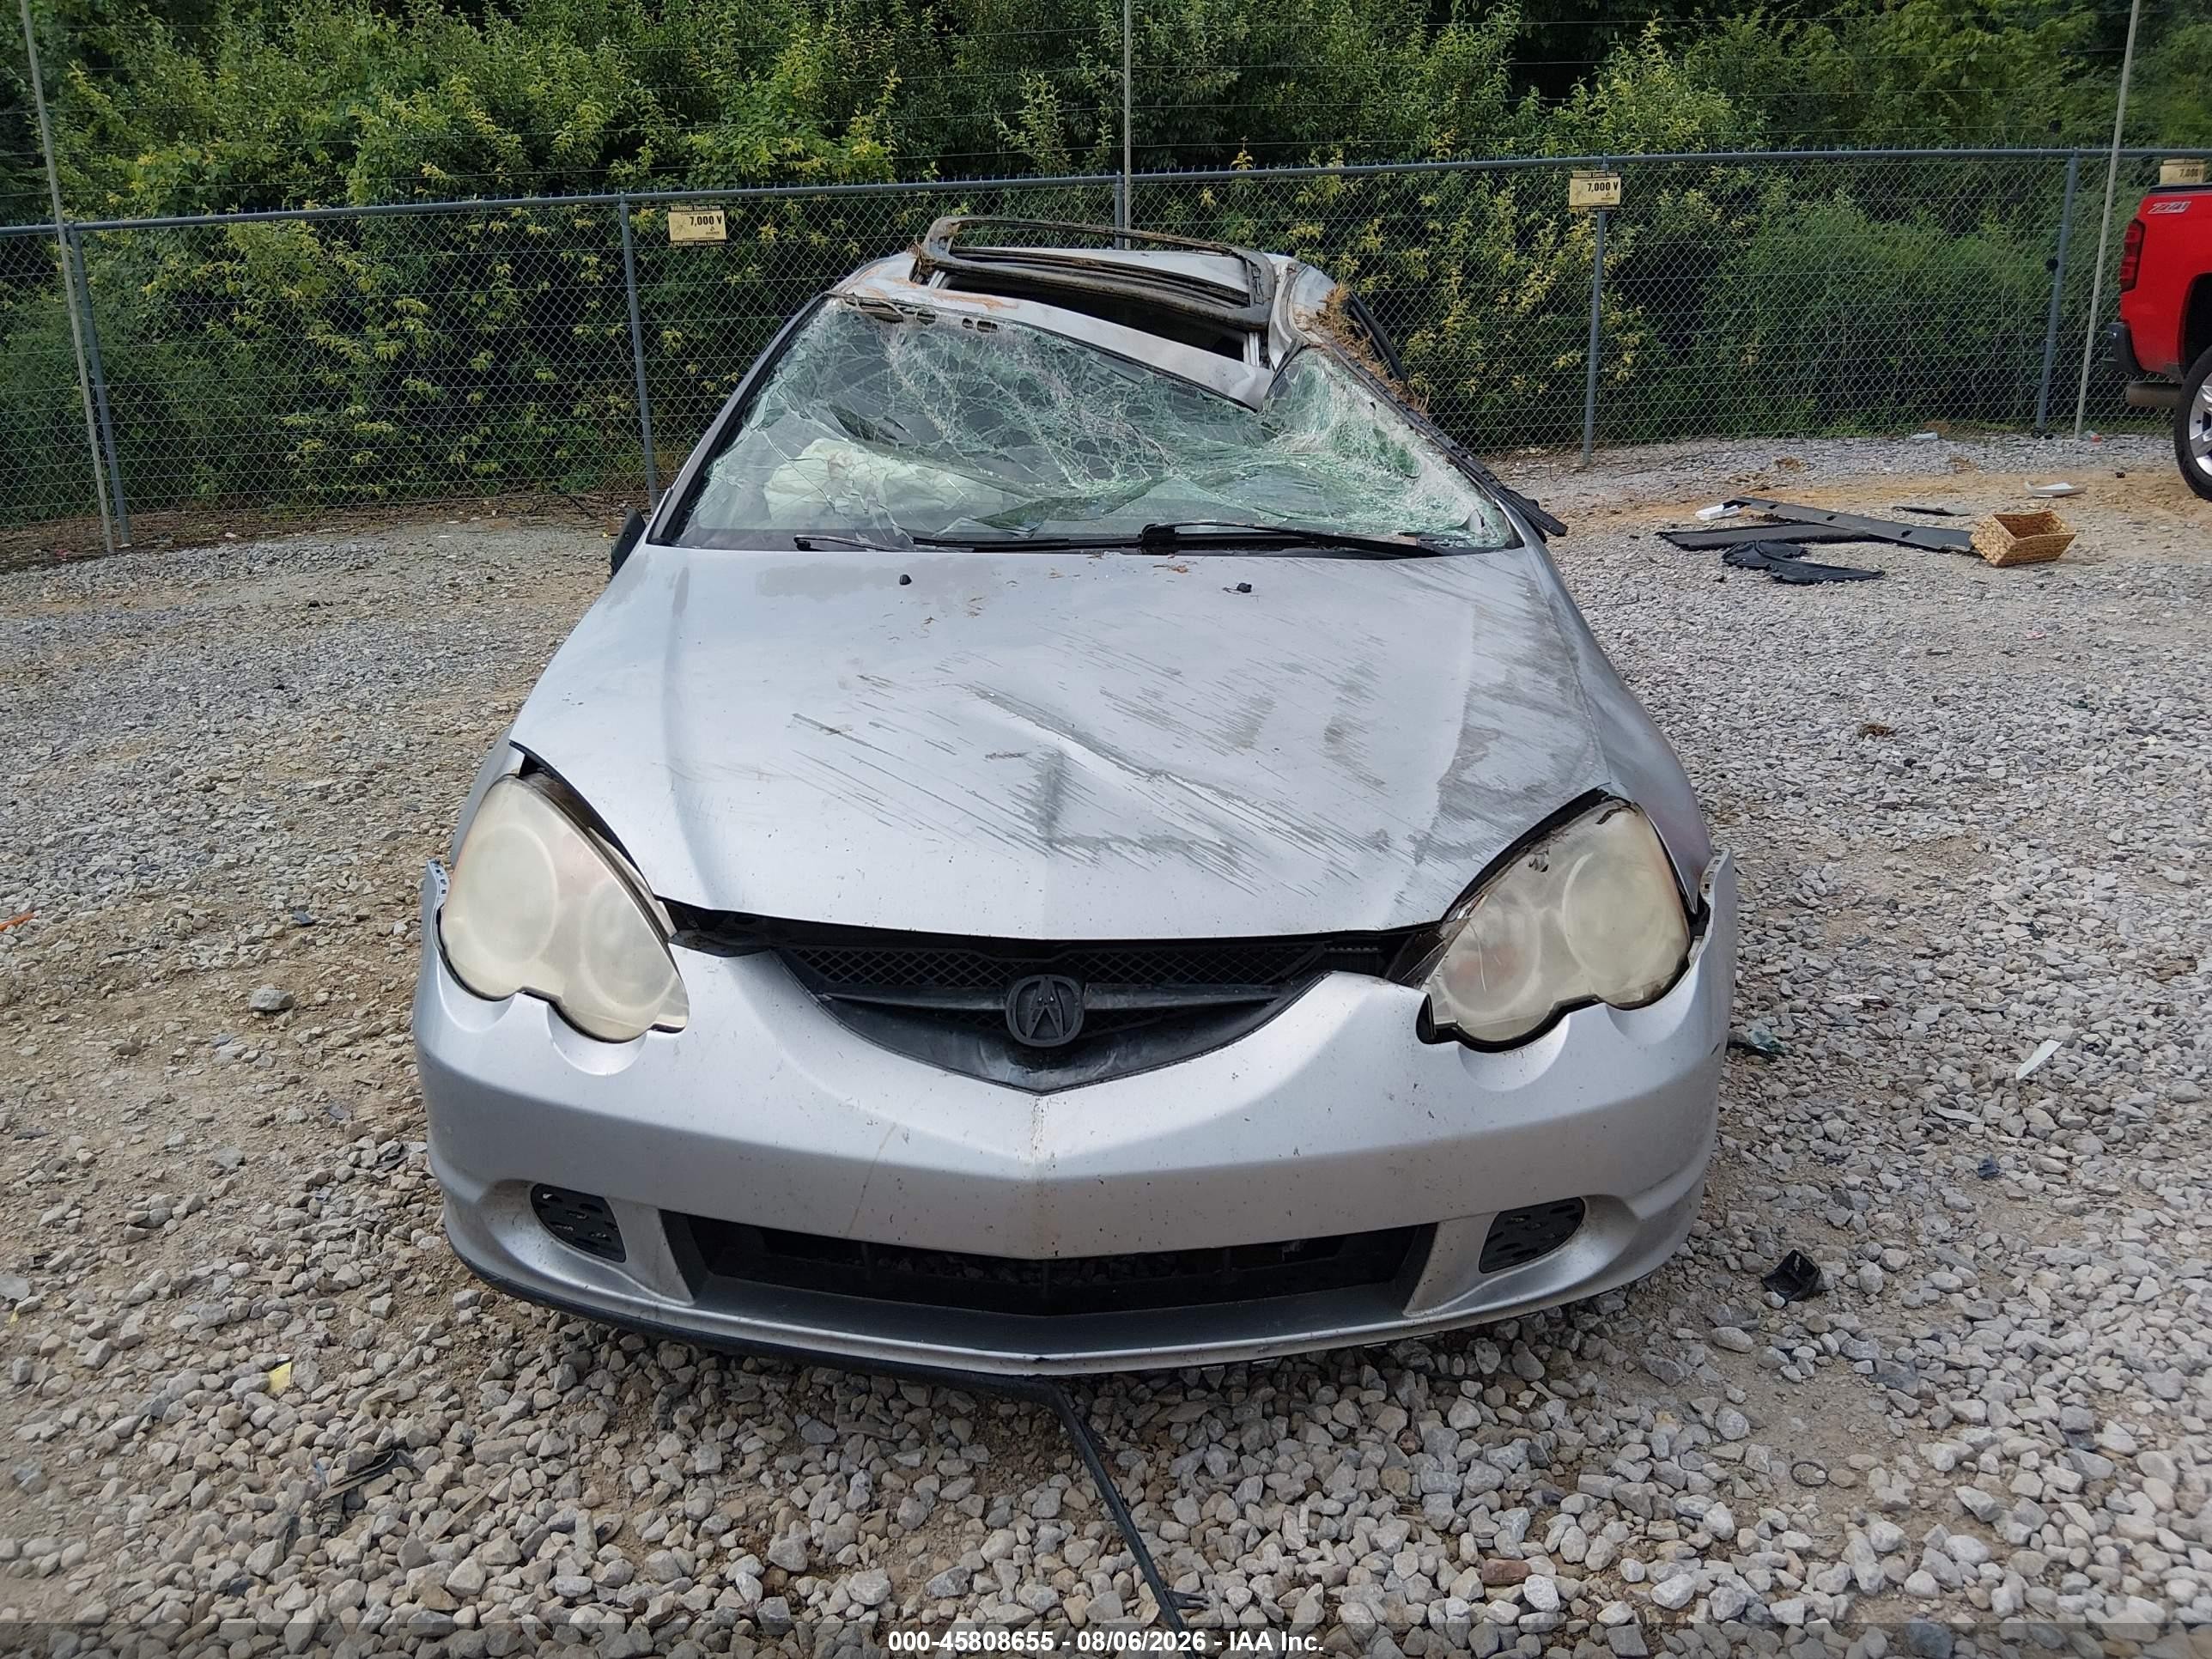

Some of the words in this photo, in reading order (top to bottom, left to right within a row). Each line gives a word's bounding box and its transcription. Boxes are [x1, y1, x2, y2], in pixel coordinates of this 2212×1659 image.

[1587, 182, 1610, 192] 7,000
[1613, 181, 1618, 191] V
[690, 216, 714, 227] 7,000
[716, 216, 722, 225] V
